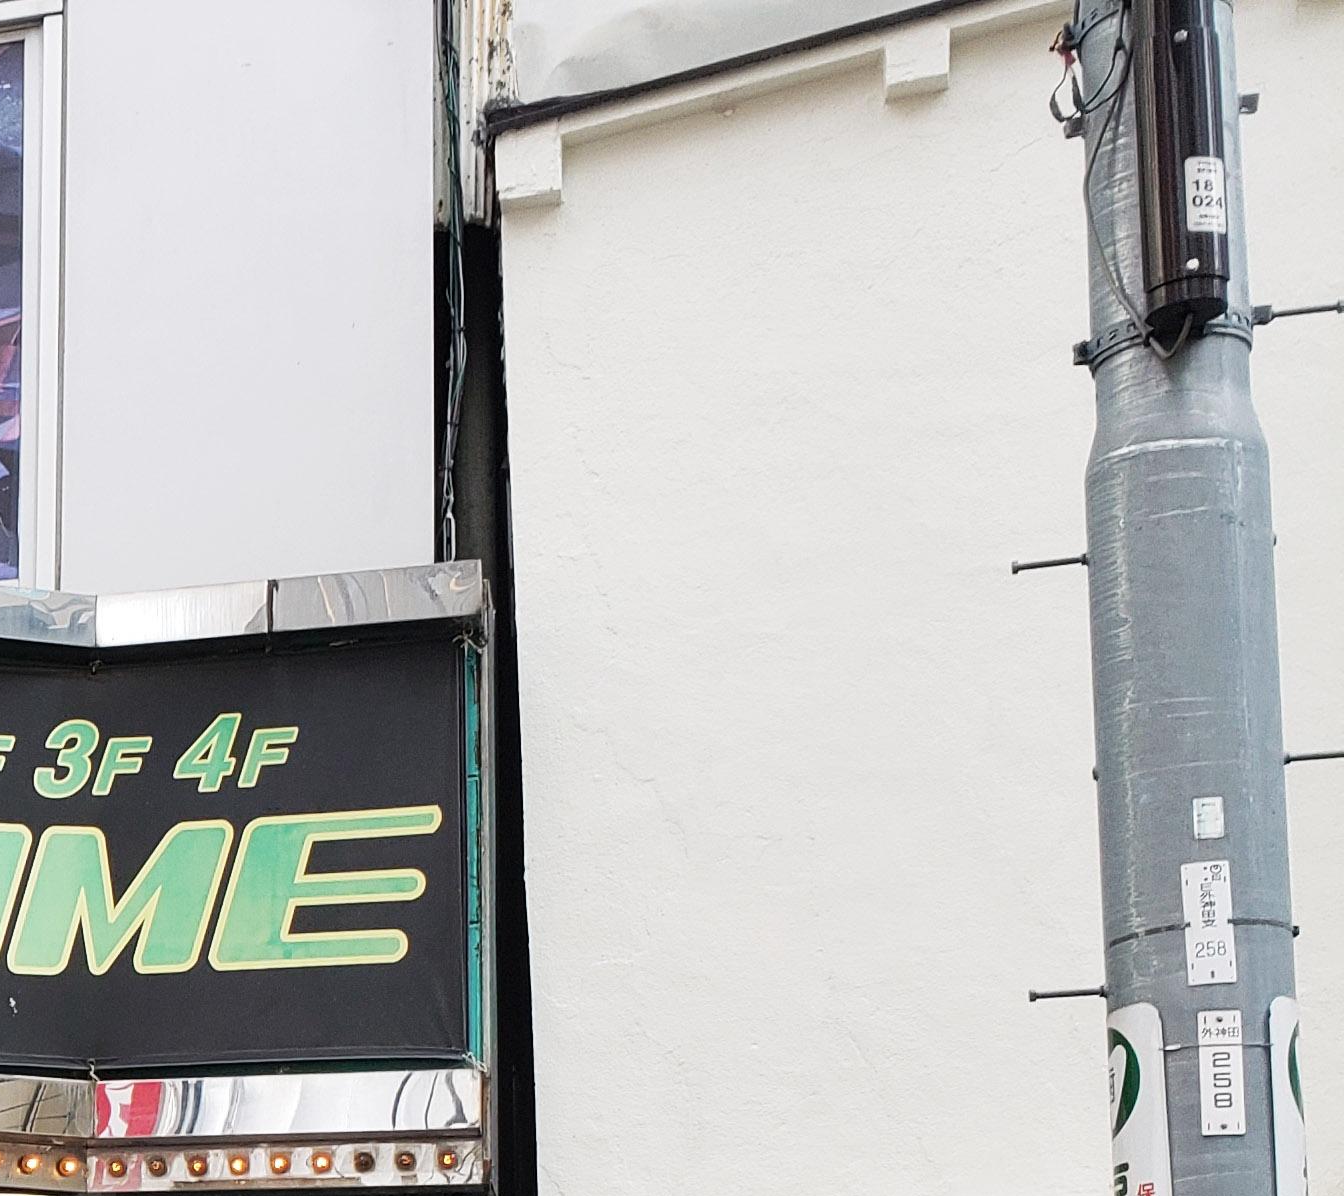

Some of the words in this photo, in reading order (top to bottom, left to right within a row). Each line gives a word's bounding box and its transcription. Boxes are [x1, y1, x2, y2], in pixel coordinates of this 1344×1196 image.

[32, 718, 153, 798] 3F
[173, 712, 299, 793] 4F
[1195, 941, 1227, 958] 258
[1201, 1027, 1240, 1039] 外神田
[1212, 1052, 1233, 1108] 258
